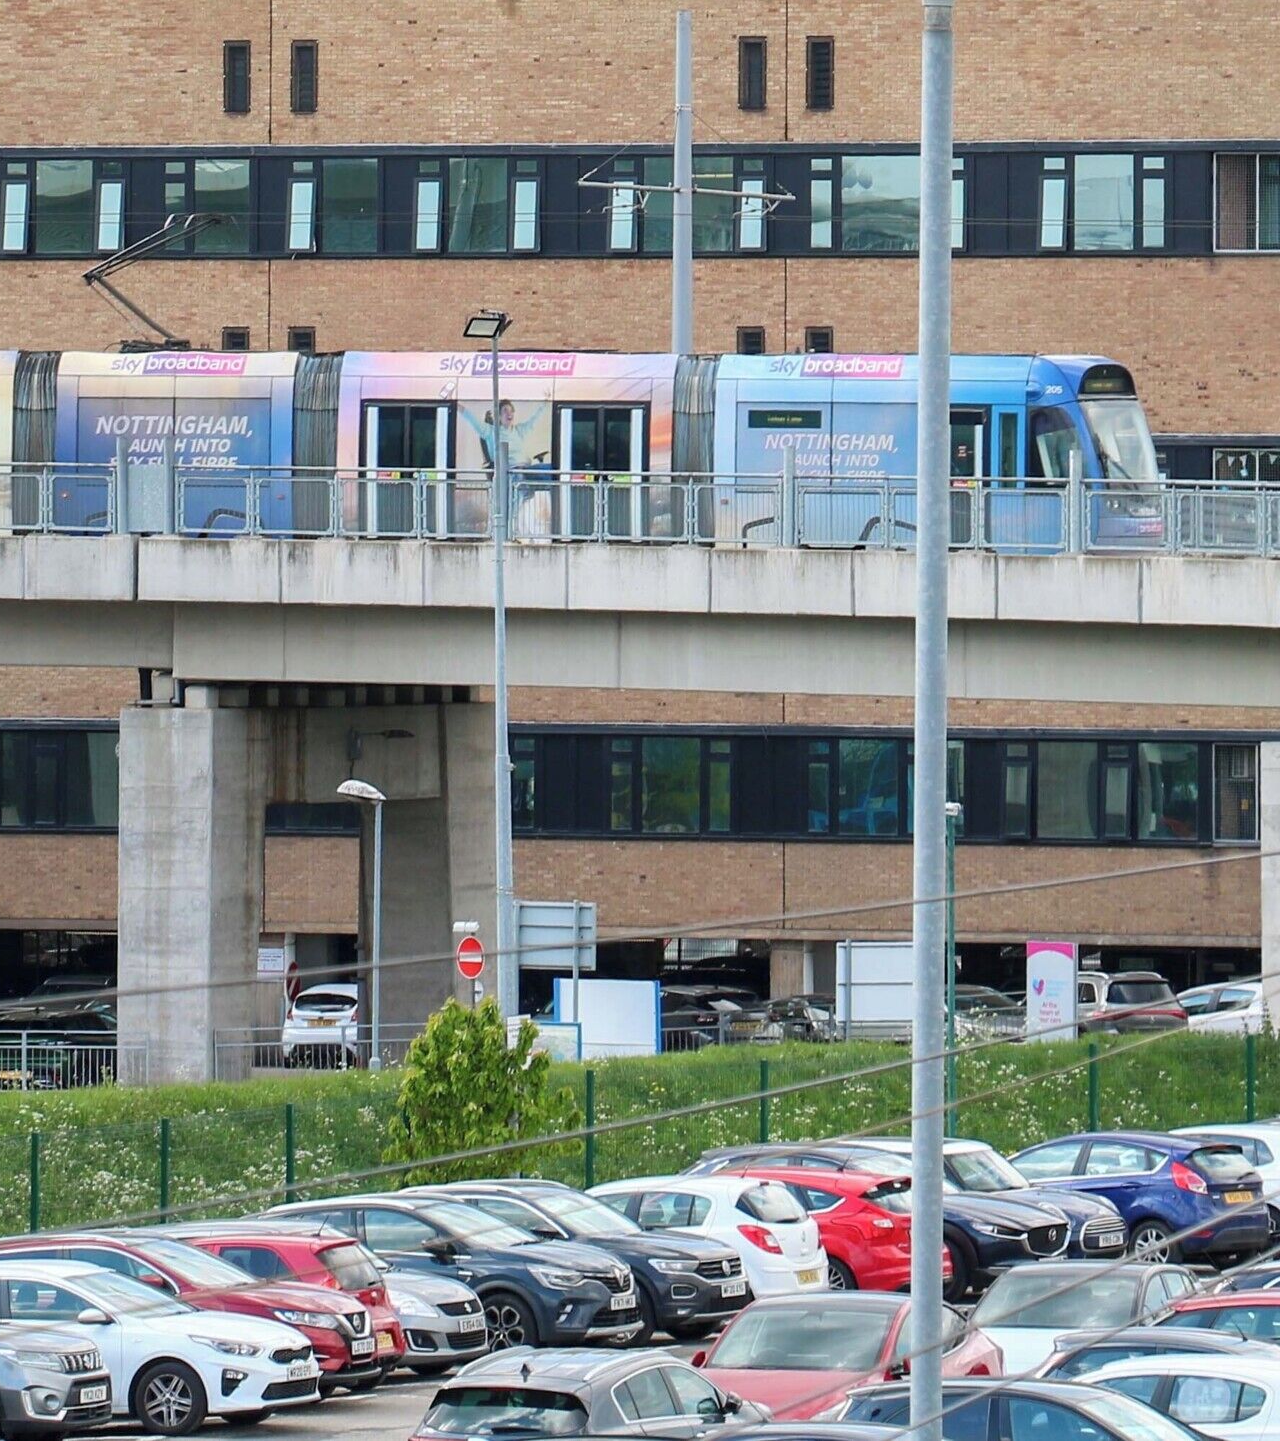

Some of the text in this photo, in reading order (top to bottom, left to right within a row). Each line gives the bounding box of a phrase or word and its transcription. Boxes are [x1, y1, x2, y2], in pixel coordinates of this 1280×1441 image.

[112, 356, 243, 374] sky broadband
[440, 356, 470, 374] sky
[769, 357, 902, 376] sky broadband
[1045, 385, 1063, 394] 205
[96, 415, 253, 438] NOTTINGHAM,
[128, 438, 231, 454] AUNH INTO
[765, 433, 897, 453] NOTTINGHAM,
[795, 453, 880, 467] AUNCH INTO
